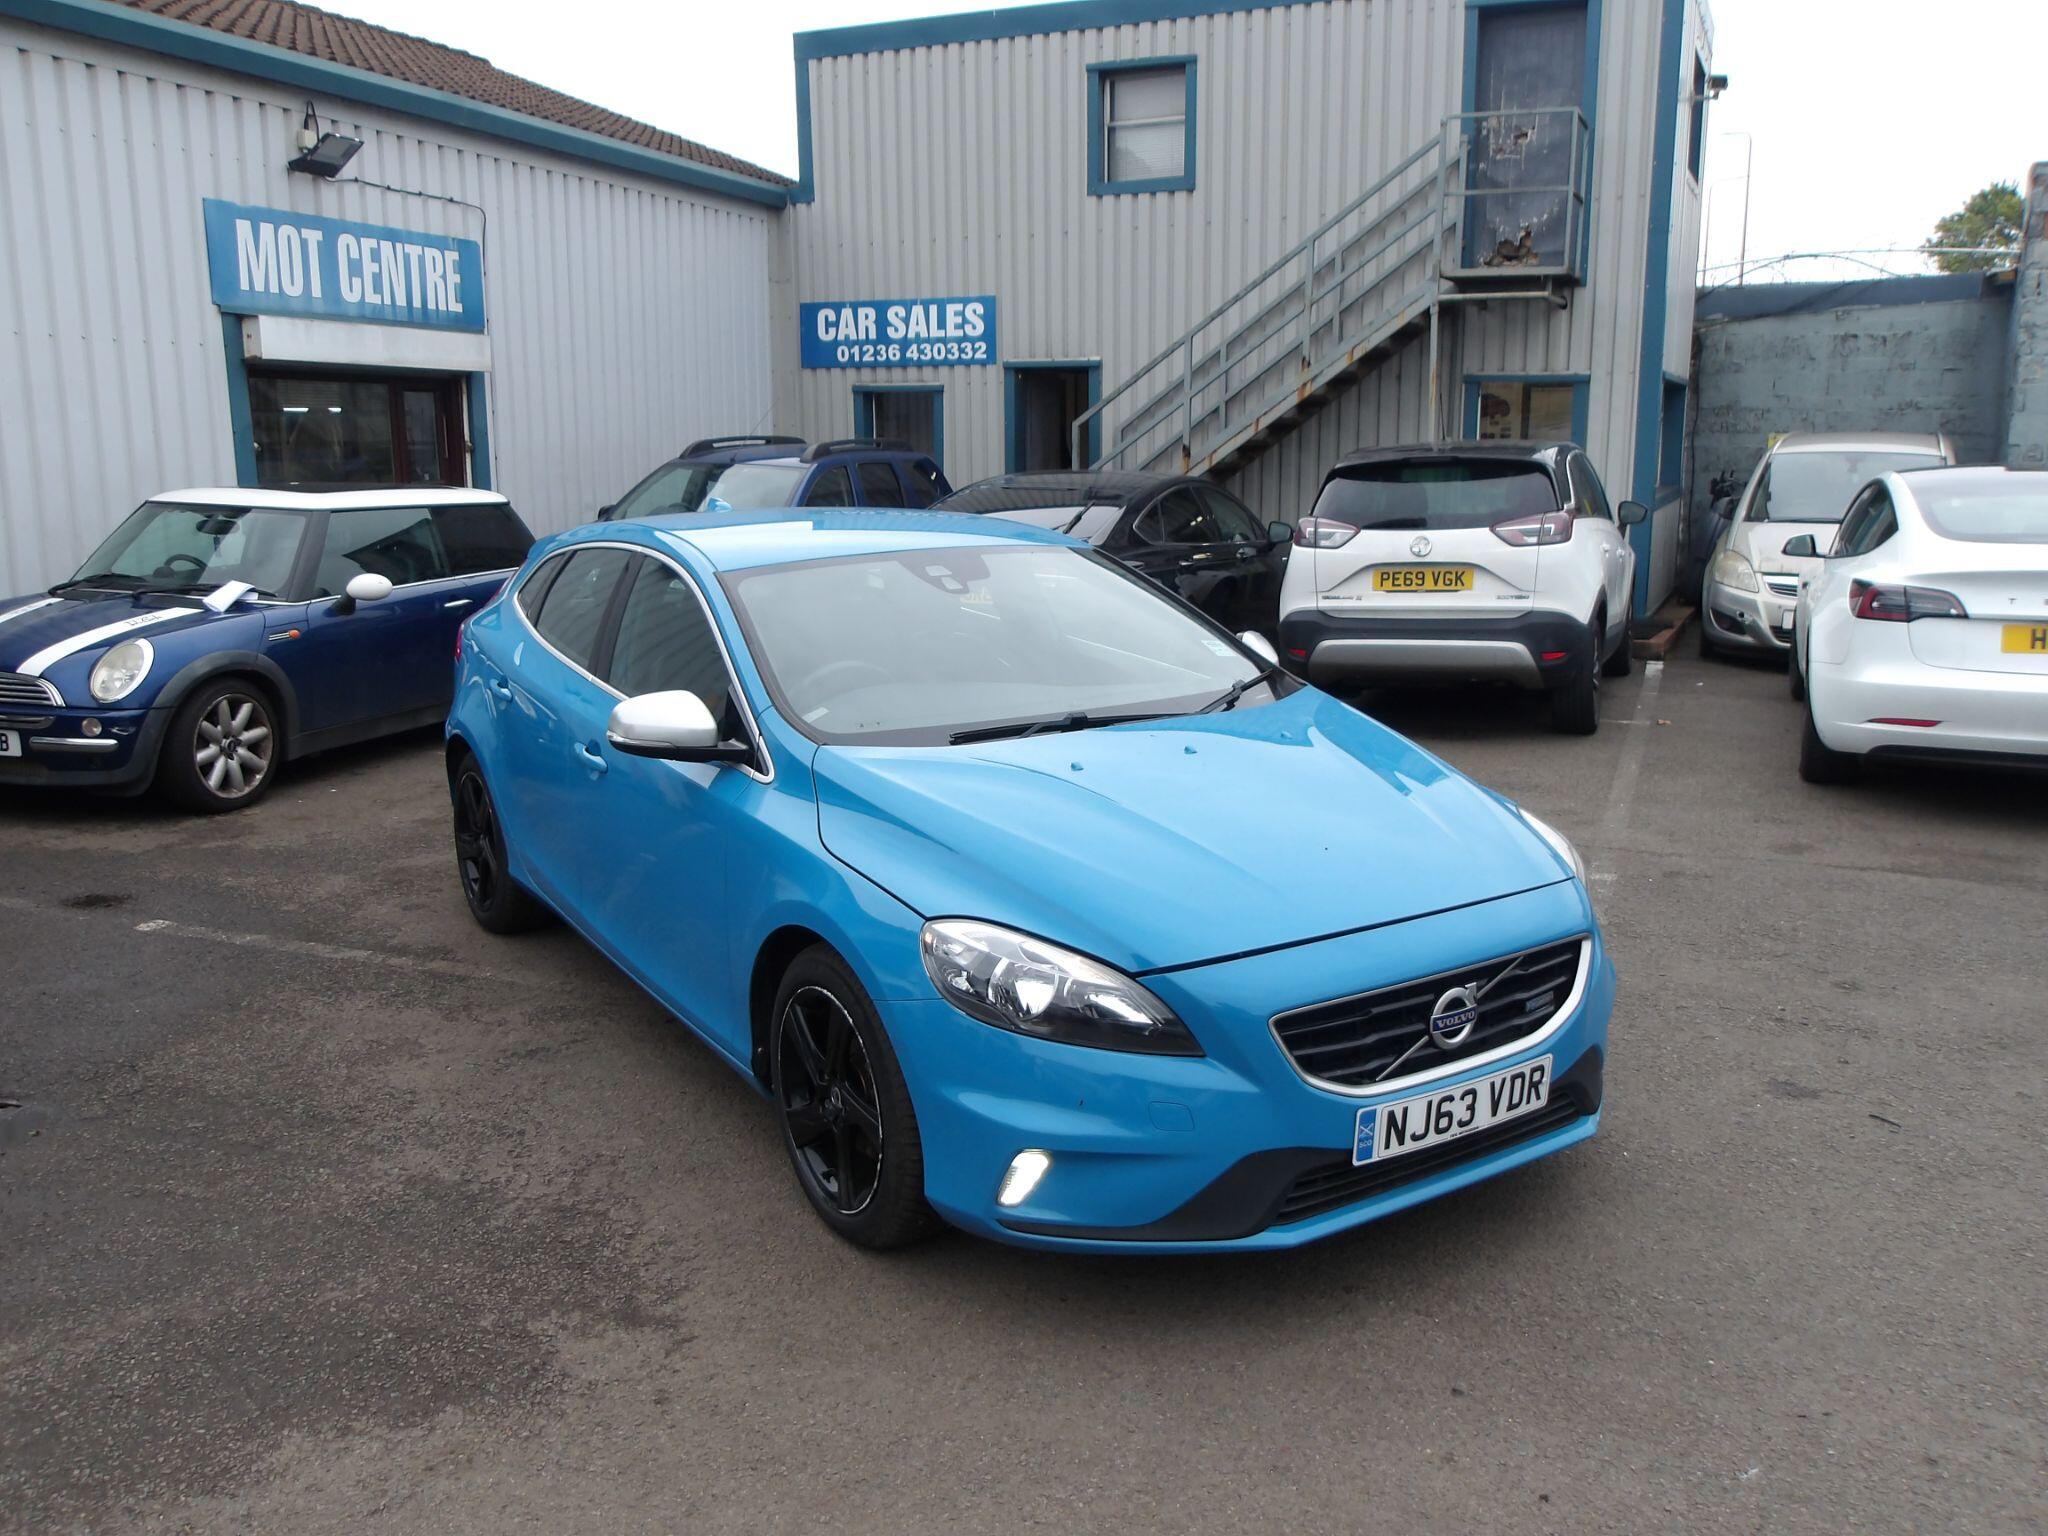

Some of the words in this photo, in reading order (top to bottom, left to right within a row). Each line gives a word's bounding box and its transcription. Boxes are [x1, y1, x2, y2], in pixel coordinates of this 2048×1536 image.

[235, 218, 323, 298] MOT
[336, 232, 463, 312] CENTRE
[817, 306, 877, 342] CAR
[886, 302, 985, 339] SALES
[836, 343, 901, 363] 01236
[905, 341, 987, 360] 430332
[1380, 570, 1426, 587] PE69
[1432, 570, 1466, 587] VGK
[1436, 1010, 1475, 1028] VOLVO
[1383, 1087, 1478, 1150] NJ63
[1489, 1063, 1545, 1118] VDR
